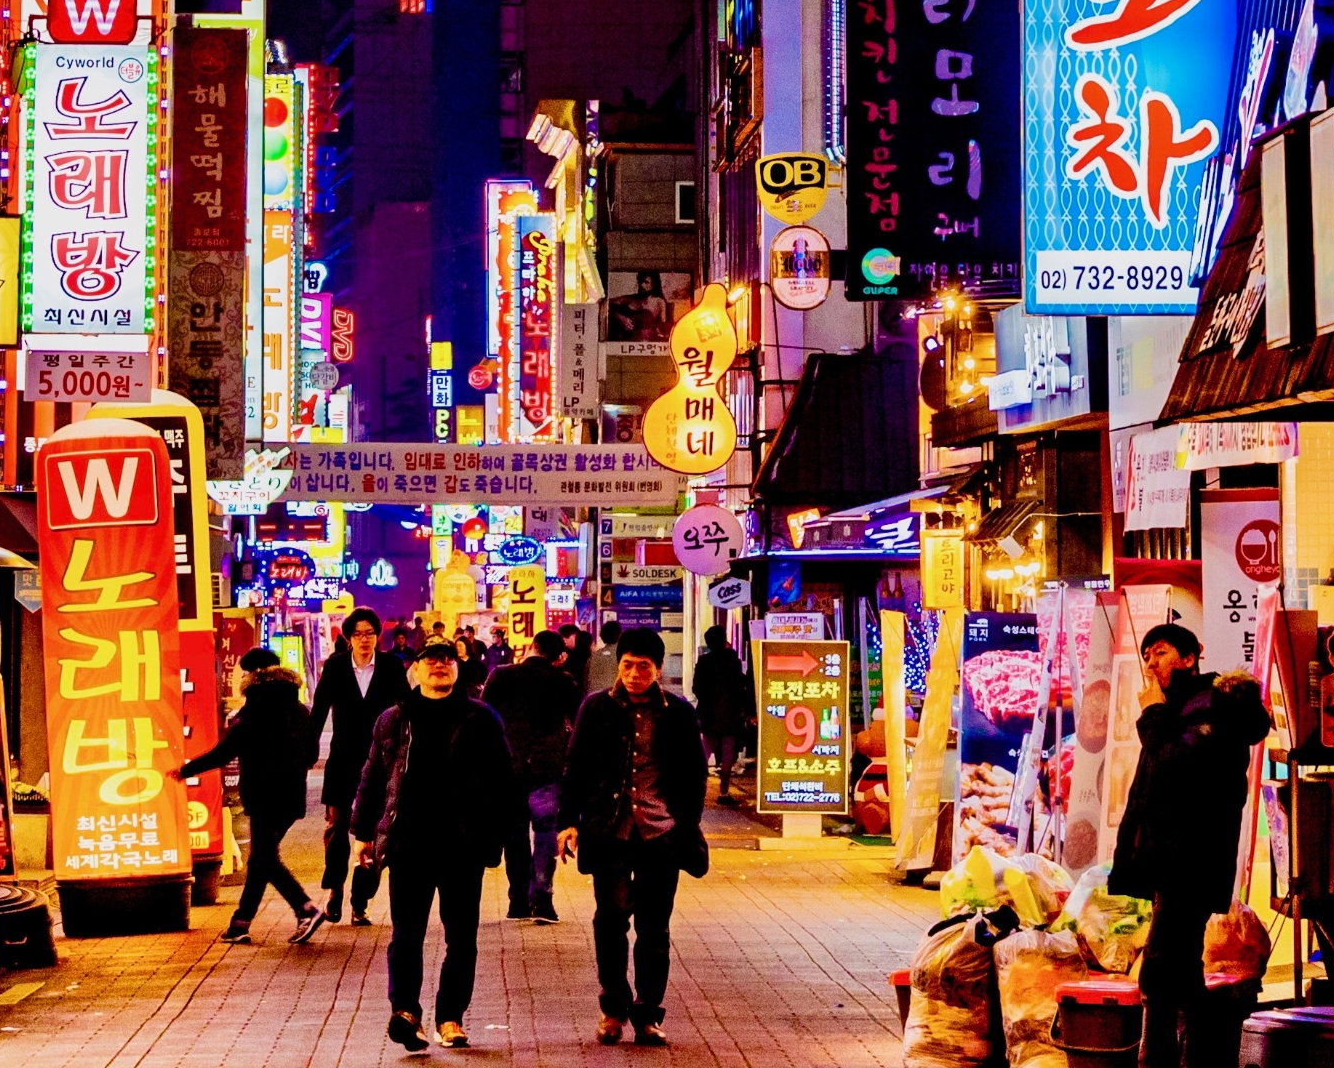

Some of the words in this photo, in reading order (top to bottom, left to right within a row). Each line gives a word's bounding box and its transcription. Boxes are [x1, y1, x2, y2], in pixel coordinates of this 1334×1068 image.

[55, 56, 115, 71] Cyworld
[189, 82, 227, 219] 해물떡찜
[763, 159, 822, 188] OB
[43, 75, 139, 302] 노래방
[1041, 268, 1067, 291] 02)
[1074, 265, 1183, 290] 732-8929
[44, 308, 133, 327] 최신시설
[679, 346, 715, 458] 월매네
[318, 451, 395, 471] 가족입니다.
[404, 452, 446, 470] 임대료
[454, 452, 505, 472] 인하하여
[511, 453, 567, 472] 골목상권
[574, 453, 616, 472] 활성화
[57, 456, 139, 520] W
[306, 473, 355, 493] 삽니다.
[362, 474, 388, 493] 을이
[394, 474, 437, 493] 죽으면
[632, 569, 676, 578] SOLDESK
[57, 539, 168, 806] 노래방
[785, 705, 815, 753] 9
[77, 813, 158, 831] 최신시설
[78, 833, 160, 849] 녹음무료
[66, 850, 178, 870] 세계각국노래
